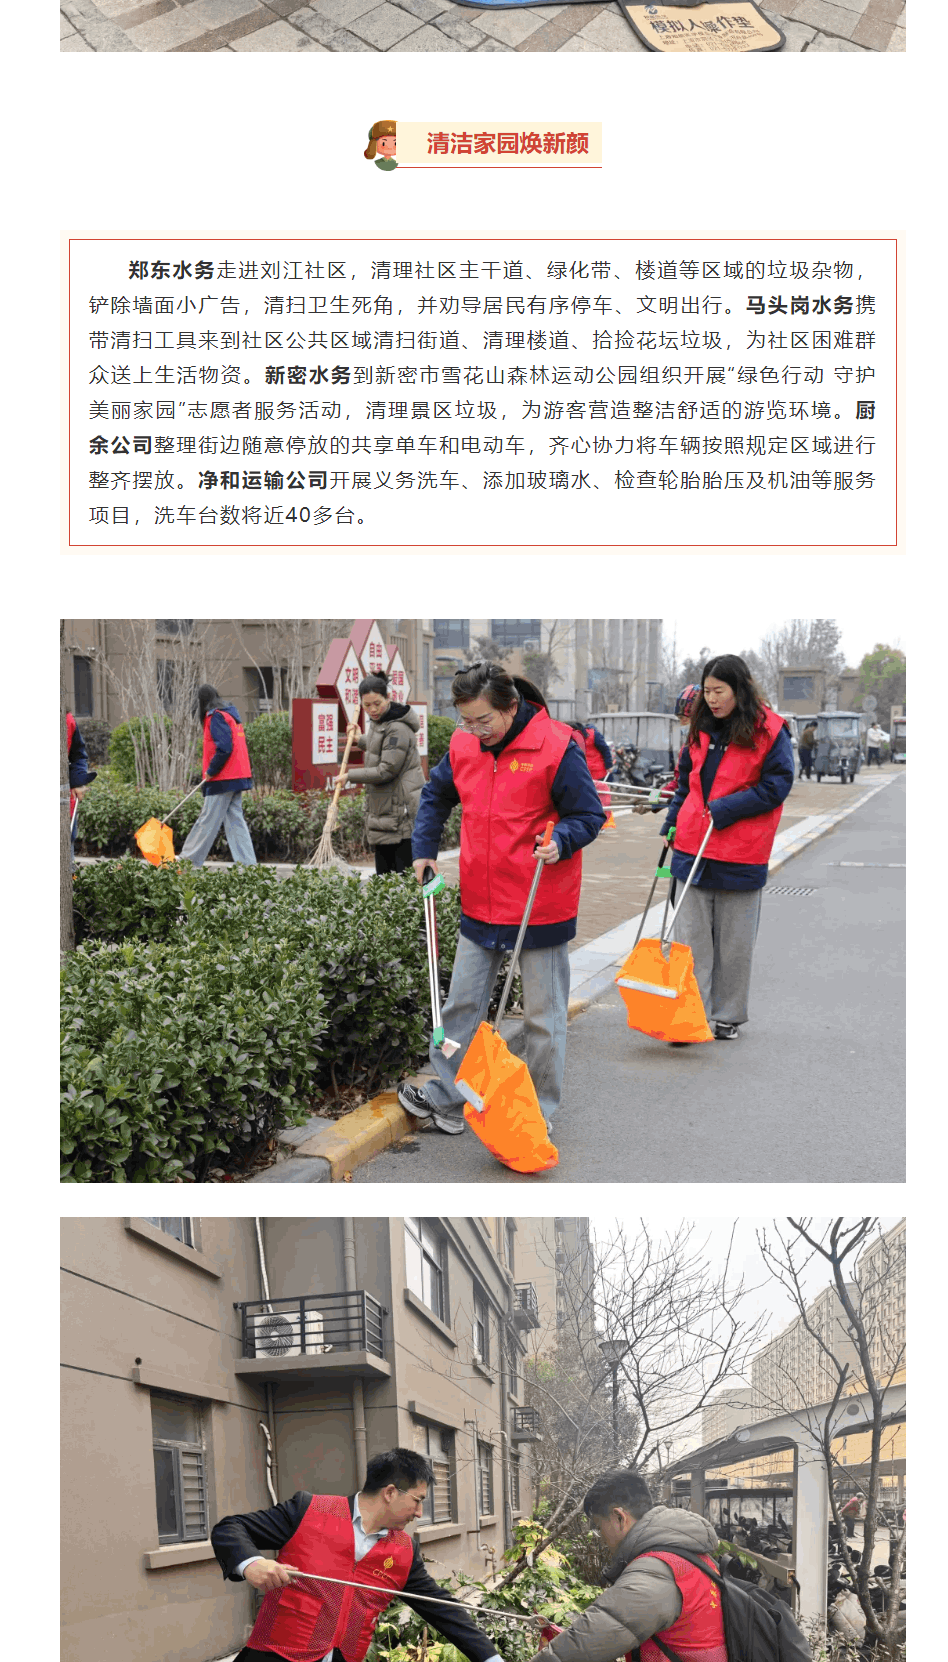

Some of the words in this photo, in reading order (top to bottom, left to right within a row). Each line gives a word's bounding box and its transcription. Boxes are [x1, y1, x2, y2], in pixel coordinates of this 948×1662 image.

[650, 15, 754, 33] 模拟人操作垫
[369, 641, 382, 658] 自由
[345, 667, 359, 683] 文明
[318, 713, 334, 732] 富强
[318, 736, 334, 754] 民主
